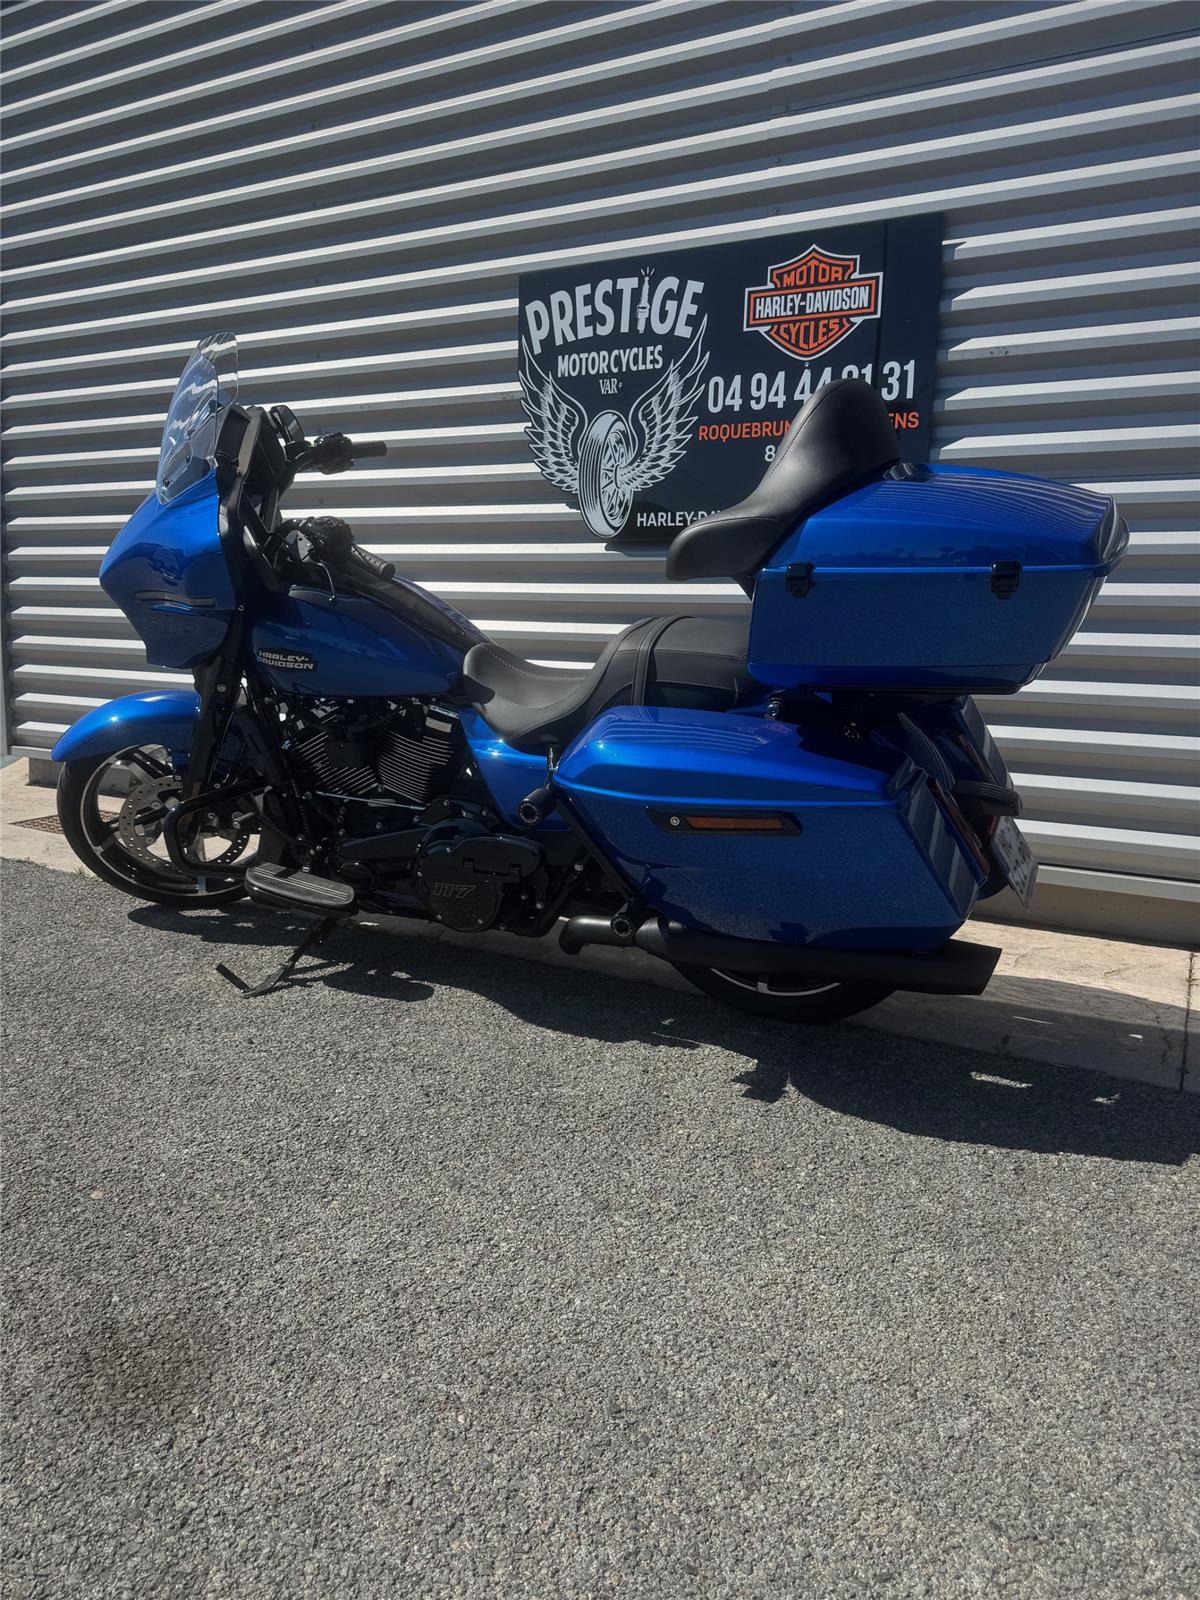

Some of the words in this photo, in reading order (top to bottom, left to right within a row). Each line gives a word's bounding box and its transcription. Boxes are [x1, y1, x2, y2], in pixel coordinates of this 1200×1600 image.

[782, 258, 843, 288] MOTOR
[524, 272, 705, 355] PRESTIGE
[754, 285, 870, 319] HARLEY-DAVIDSON
[779, 318, 840, 350] CYCLES
[557, 344, 663, 378] MOTORCYCLES
[599, 378, 618, 395] VAR
[707, 374, 743, 413] 04
[750, 370, 786, 411] 94
[881, 359, 915, 401] 31
[256, 656, 314, 670] DAVIDSON
[433, 882, 476, 899] 117
